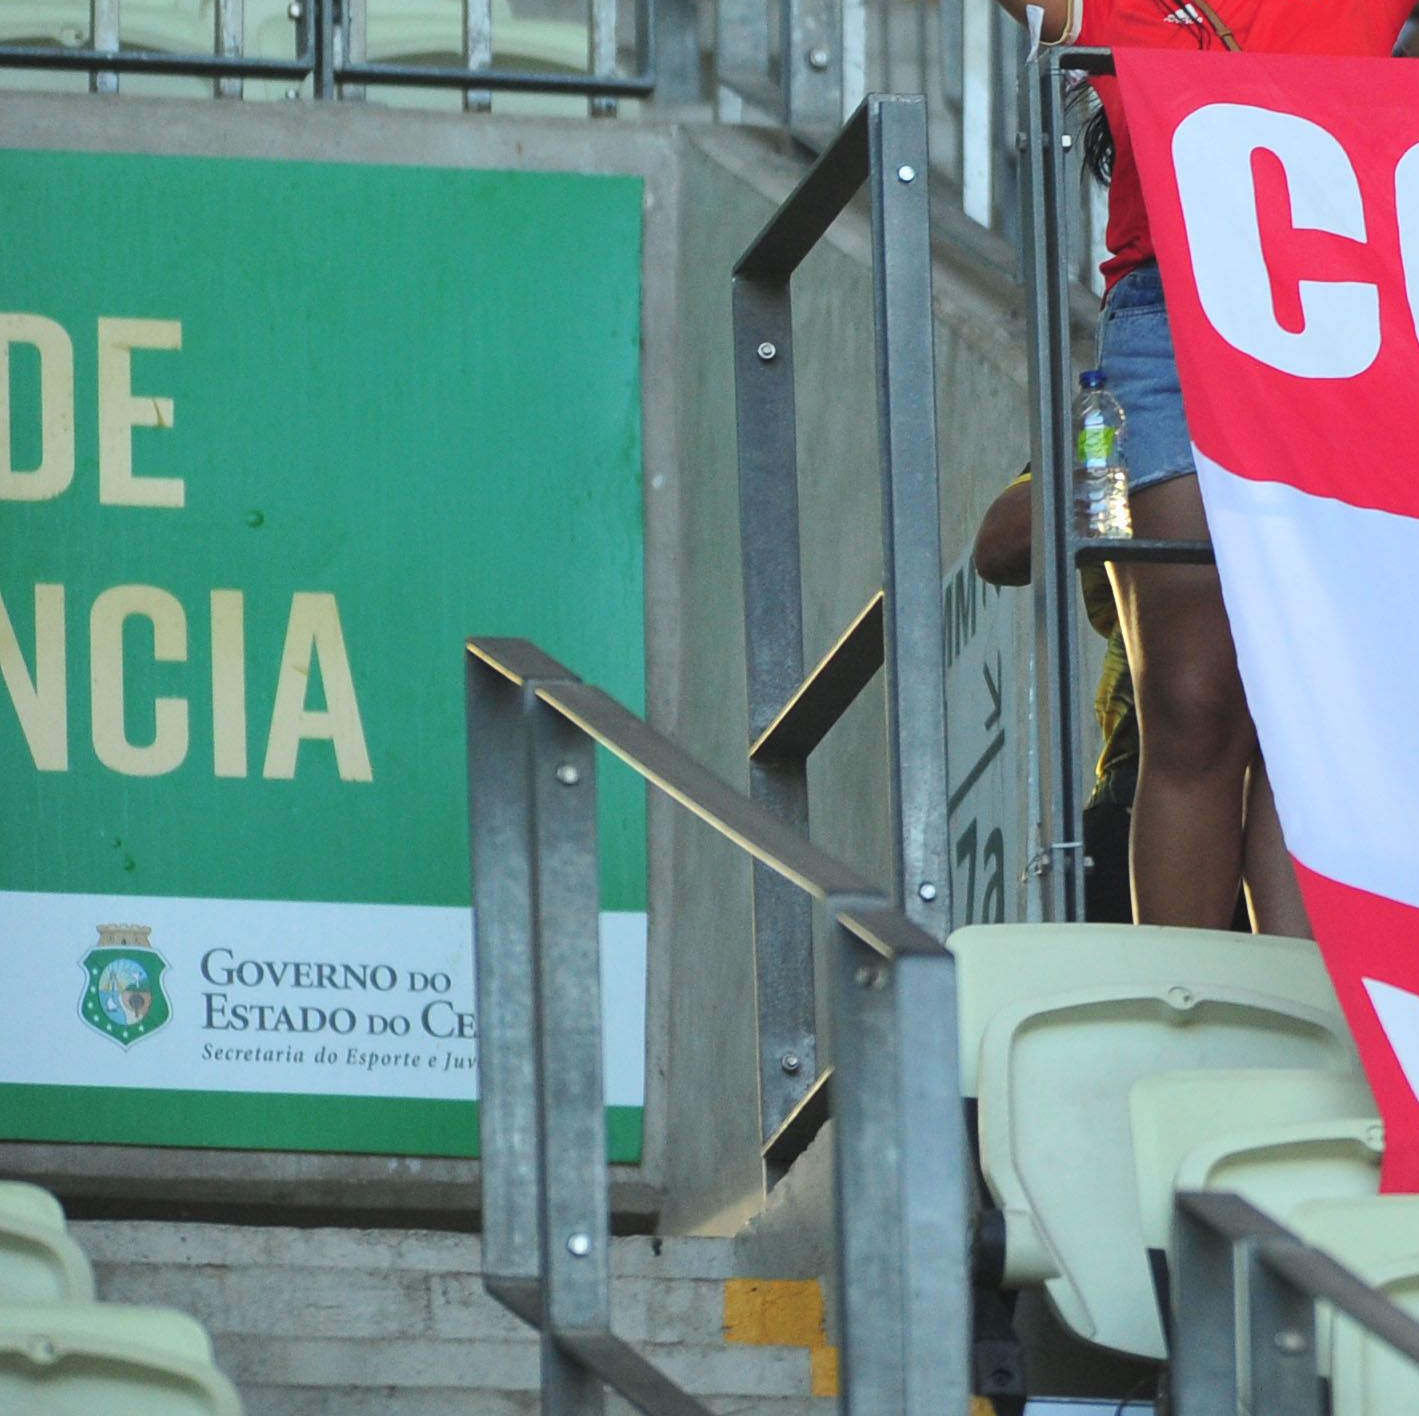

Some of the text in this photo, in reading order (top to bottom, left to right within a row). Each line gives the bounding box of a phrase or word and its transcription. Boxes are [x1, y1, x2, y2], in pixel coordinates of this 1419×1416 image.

[0, 310, 186, 509] DE
[0, 584, 374, 782] NCIA
[201, 1042, 305, 1064] Secretaria
[314, 1045, 338, 1065] do
[346, 1047, 421, 1071] Esporte
[427, 1057, 439, 1069] e
